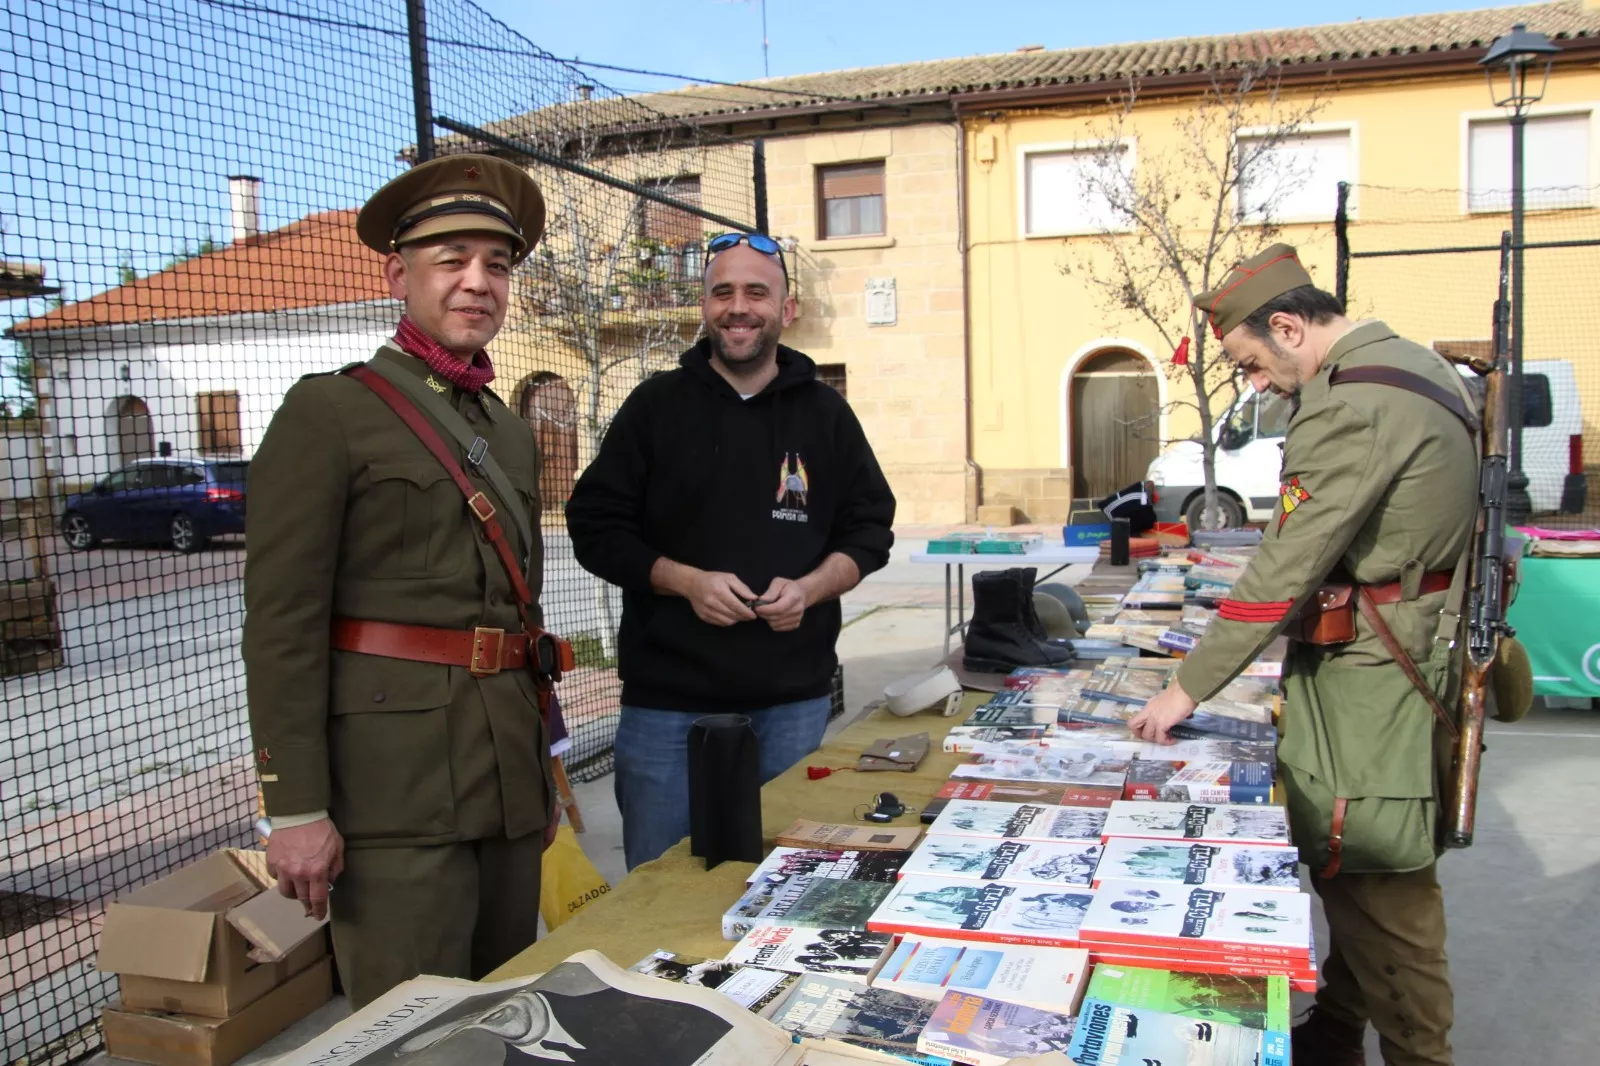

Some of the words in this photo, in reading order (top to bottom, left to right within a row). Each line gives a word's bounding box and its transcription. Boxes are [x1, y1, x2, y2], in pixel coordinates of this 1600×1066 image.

[567, 882, 612, 913] CALZADOS
[767, 876, 813, 917] BATALLAS
[975, 887, 1005, 911] Civil
[1188, 892, 1213, 918] Civil
[761, 927, 794, 945] Norte
[744, 944, 780, 965] Frente
[309, 995, 440, 1066] NGUARDIA
[1072, 1003, 1112, 1066] Portaviones
